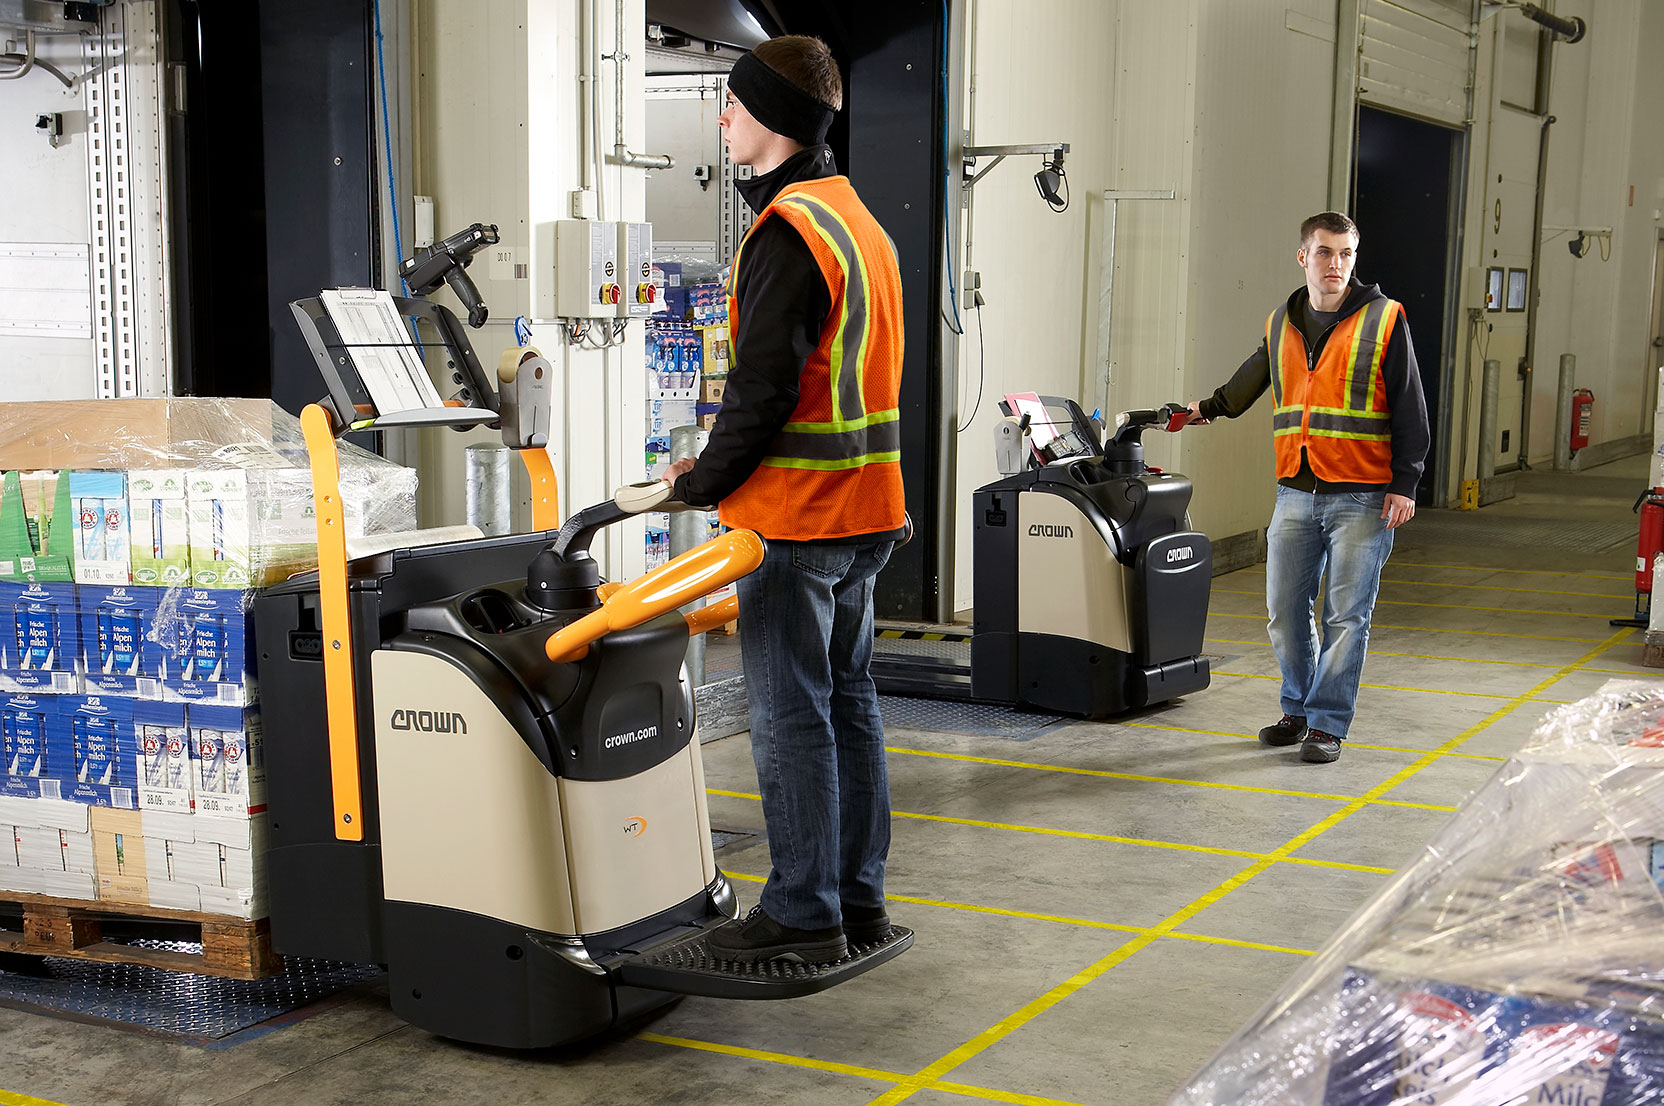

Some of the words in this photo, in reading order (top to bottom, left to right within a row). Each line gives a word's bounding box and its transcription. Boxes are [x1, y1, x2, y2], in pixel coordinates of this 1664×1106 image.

[1494, 198, 1501, 234] 9
[1028, 524, 1073, 538] CROWN
[1166, 546, 1194, 563] CROWN
[29, 629, 47, 639] Alpen
[30, 638, 47, 647] milch
[113, 634, 132, 645] Alpen
[196, 639, 216, 650] Alpen
[114, 643, 132, 652] milch
[197, 649, 215, 658] milch
[391, 709, 467, 734] CROWN
[17, 737, 34, 747] Alpen
[604, 725, 657, 749] crown.com
[18, 746, 34, 755] milch
[88, 742, 106, 752] Alpen
[89, 751, 105, 760] milch
[623, 822, 638, 833] WT
